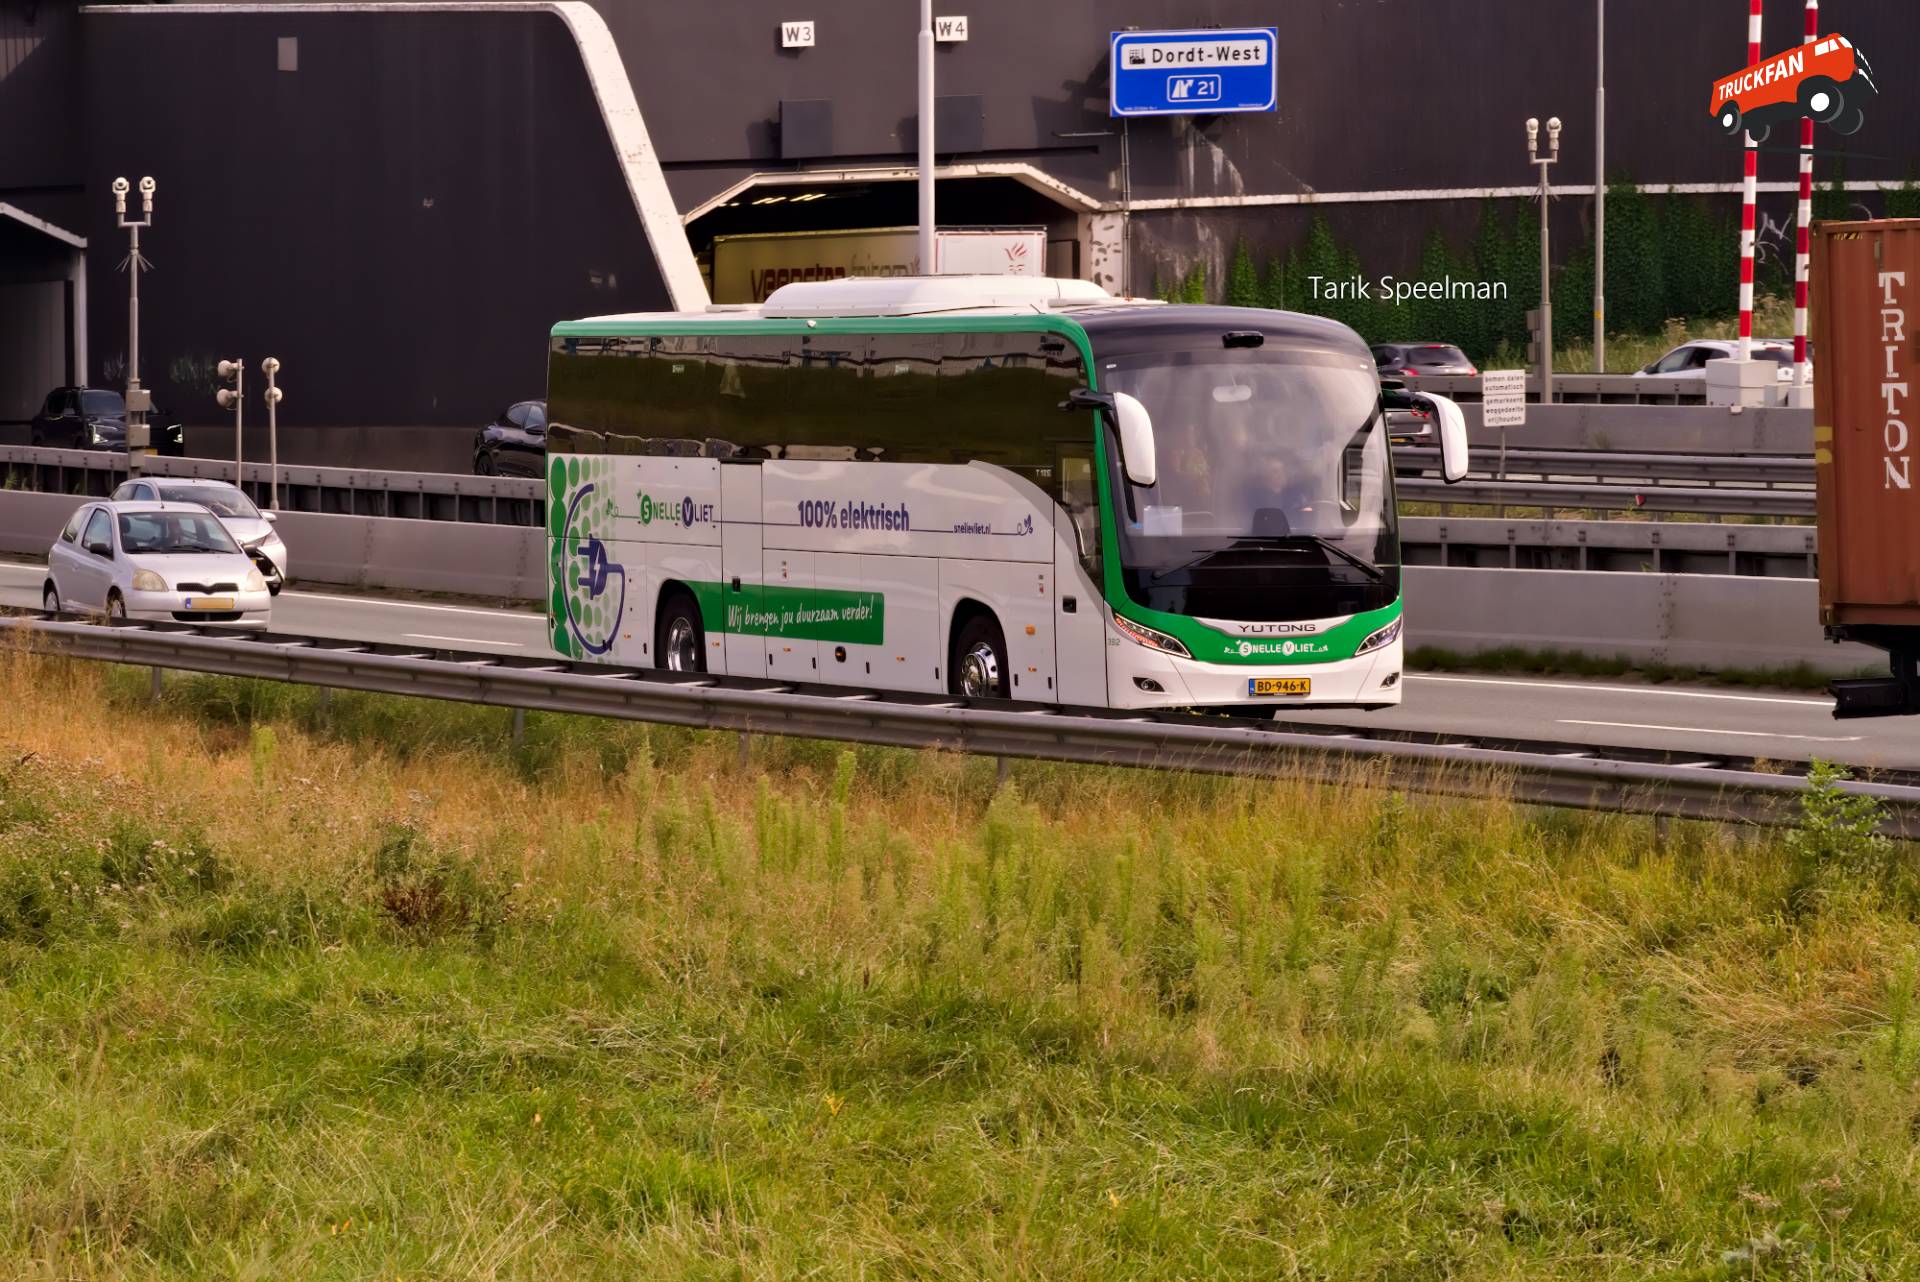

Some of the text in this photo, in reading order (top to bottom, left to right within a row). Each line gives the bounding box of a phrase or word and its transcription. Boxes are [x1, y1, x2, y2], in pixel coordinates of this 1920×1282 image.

[1152, 45, 1261, 64] Dordt-West
[1197, 80, 1216, 95] 21
[1878, 271, 1911, 489] TRITON
[798, 500, 910, 531] 100% elektrisch
[953, 522, 991, 535] snellevliet.nl
[728, 594, 875, 632] Wij brengen jou duurzaam verder!
[1239, 623, 1317, 633] YUTONG
[1257, 681, 1306, 692] BD-946-K
